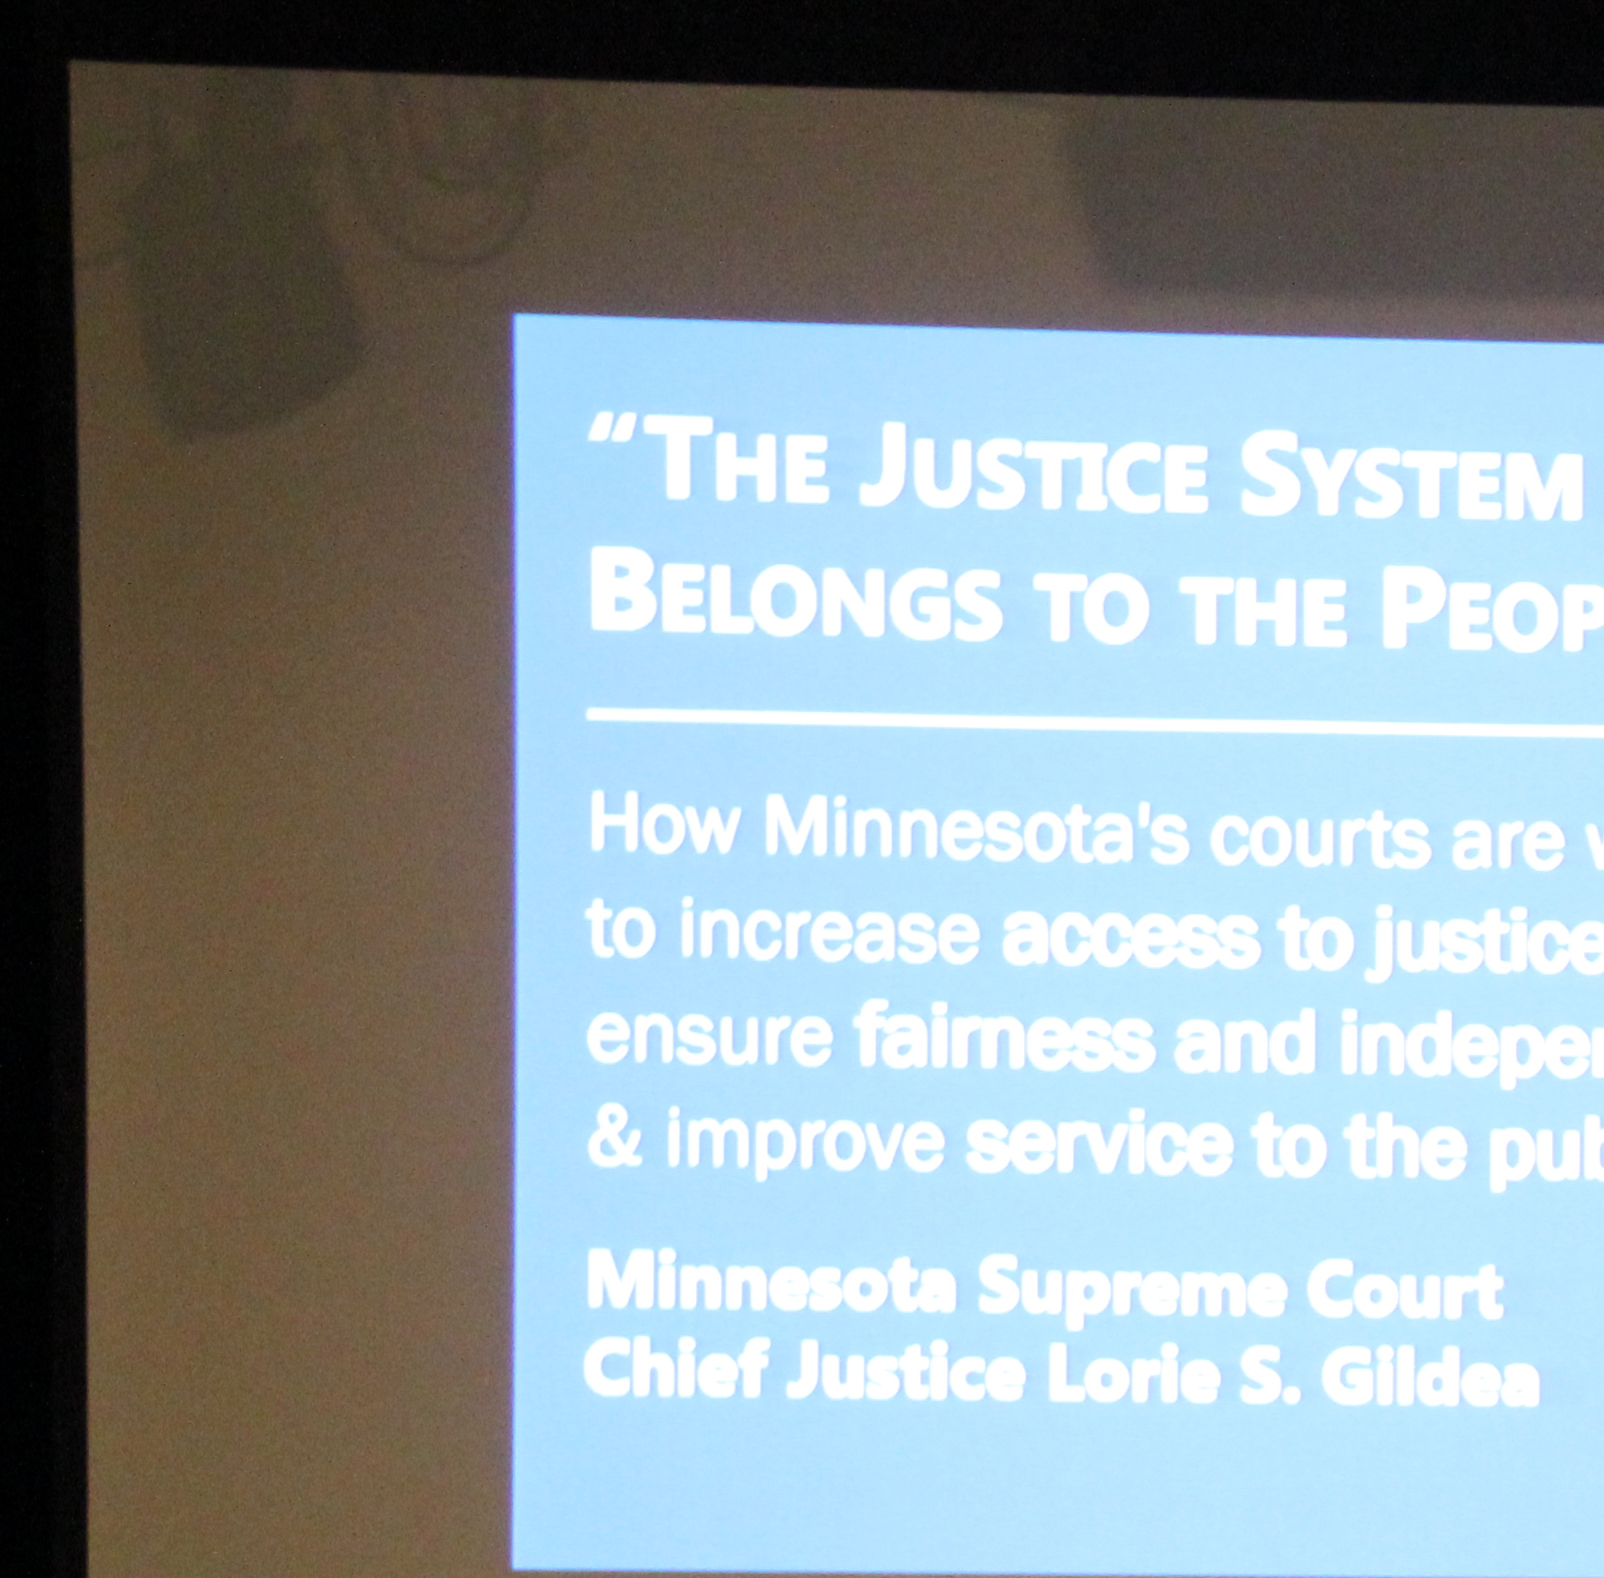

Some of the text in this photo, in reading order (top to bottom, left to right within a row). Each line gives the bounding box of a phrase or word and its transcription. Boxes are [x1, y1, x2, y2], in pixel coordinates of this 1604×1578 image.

[859, 421, 1209, 515] JUSTICE
[1240, 429, 1584, 522] SYSTEM
[590, 545, 1004, 643] BELONGS
[1032, 572, 1151, 646] TO
[1178, 576, 1349, 649] THE
[590, 790, 742, 857] How
[765, 793, 1191, 866] Minnesota's
[1209, 808, 1433, 871] courts
[1451, 819, 1566, 873] are
[584, 897, 657, 959] to
[681, 895, 981, 966] increase
[1001, 910, 1263, 971] access
[1276, 904, 1355, 972] to
[586, 1012, 834, 1068] ensure
[852, 998, 1157, 1074] fairness
[1173, 1007, 1317, 1076] and
[587, 1102, 643, 1168] &
[667, 1105, 946, 1183] improve
[965, 1107, 1235, 1178] service
[1250, 1111, 1329, 1180] to
[1341, 1111, 1469, 1181] the
[586, 1248, 1505, 1333] Minnesota Supreme Court
[583, 1335, 1541, 1408] Chief Justice Lorie S. Gildea
